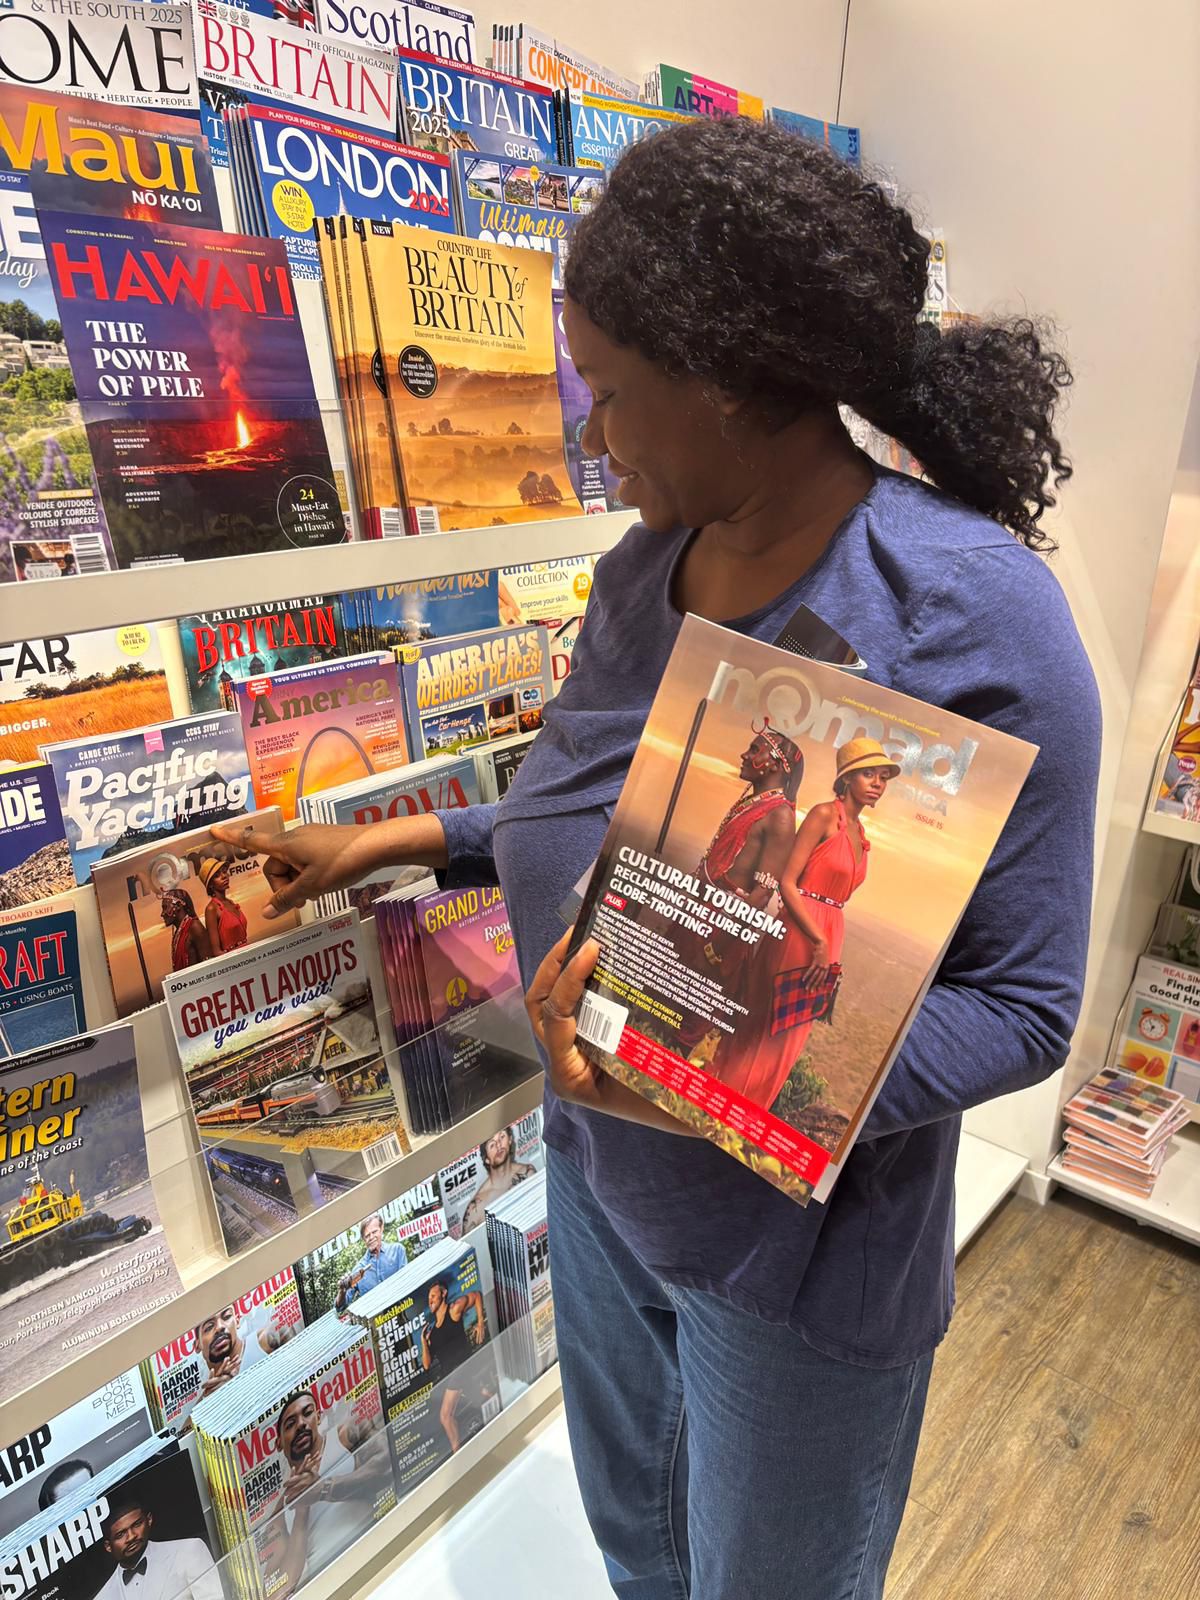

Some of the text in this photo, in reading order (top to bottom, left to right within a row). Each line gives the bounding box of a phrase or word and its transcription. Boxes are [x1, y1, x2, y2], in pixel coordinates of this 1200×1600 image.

[31, 1, 183, 24] & THE SOUTH 2025
[424, 4, 468, 21] CLANS HISTORY
[327, 0, 473, 66] Scotland
[0, 14, 190, 94] OME
[306, 39, 321, 51] THE
[323, 42, 355, 61] OFFICIAL
[356, 54, 395, 72] MAGAZINE
[202, 16, 394, 122] BRITAIN
[449, 60, 525, 87] ESSENTIAL GUIDE
[539, 41, 633, 98] BEST DIGITAL GAMES
[203, 71, 294, 100] HISTORY TRAVEL CULTURE
[107, 94, 153, 105] HERITAGE
[160, 98, 193, 107] PEOPLE
[401, 62, 551, 143] BRITAIN
[269, 111, 358, 140] PLAN YOUR PERFECT PAGES
[411, 110, 450, 139] 2025
[0, 101, 201, 194] Maui
[504, 142, 540, 162] GREAT
[254, 120, 448, 208] LONDON
[131, 189, 157, 207] NŌ
[280, 185, 302, 197] WIN
[409, 189, 450, 217] 2025
[281, 204, 294, 212] STAY
[480, 203, 568, 239] Ultimate
[288, 220, 306, 229] HOTEL
[373, 226, 392, 236] NEW
[437, 240, 492, 260] COUNTRY LIFE
[403, 246, 528, 301] BEAUTY of
[409, 287, 525, 339] BRITAIN
[86, 321, 147, 344] THE
[92, 348, 191, 372] POWER
[408, 354, 424, 362] Inside
[98, 376, 205, 398] OF PELE
[57, 499, 96, 508] OUTDOORS,
[291, 502, 329, 513] Must-Eat
[299, 488, 314, 501] 24
[18, 509, 63, 520] COLOURS OF
[30, 515, 99, 528] STYLISH STAIRCASES
[294, 524, 303, 532] in
[298, 512, 326, 522] Dishes
[517, 571, 569, 588] COLLECTION
[576, 576, 588, 589] 19
[201, 596, 323, 622] ARANORMAL
[520, 595, 569, 609] Improve your skills
[193, 606, 337, 673] BRITAIN
[0, 636, 75, 681] FAR
[418, 631, 539, 682] AMERICA'S
[274, 658, 377, 684] YOUR ULTIMATE TRAVEL COMPANION
[417, 650, 543, 710] WEIRDEST PLACES!
[250, 678, 391, 728] America
[0, 718, 50, 736] BIGGER.
[79, 748, 101, 761] CANOE
[102, 745, 121, 757] COVE
[10, 778, 23, 787] U.S.
[65, 747, 219, 812] Pacific
[260, 767, 295, 780] ROCKET CITY
[62, 775, 251, 850] Yachting
[914, 812, 944, 831] ISSUE 15
[229, 860, 260, 876] FRICA
[604, 893, 624, 910] PLUS:
[613, 864, 761, 945] RECLAIMING THE LURE OF
[618, 846, 788, 941] CULTURAL TOURISM:
[35, 906, 54, 916] SKIFF
[424, 890, 479, 934] GRAND
[609, 879, 714, 939] GLOBE-TROTTING?
[656, 935, 675, 949] KENYA
[0, 931, 67, 990] RAFT
[171, 931, 323, 993] 90+ MUST-SEE DESTINATIONS HANDY LOCATION MAP
[1162, 967, 1186, 981] REAL
[20, 983, 74, 1005] USING BOATS
[180, 938, 358, 1040] GREAT LAYOUTS
[1149, 984, 1180, 1001] Good
[214, 968, 337, 1049] you can visit!
[710, 1016, 735, 1034] TOURISM
[18, 1137, 84, 1170] of the Coast
[440, 1151, 478, 1178] STRENGTH
[444, 1163, 477, 1193] SIZE
[399, 1214, 442, 1239] WILLIAM MACY
[100, 1245, 164, 1278] Waterfront
[18, 1264, 147, 1328] NORTHERN VANCOUVER ISLAND
[460, 1274, 479, 1292] FUN!
[16, 1266, 170, 1343] Port Hardy, Telegraph Cove Kelsey Bay
[61, 1295, 171, 1351] ALUMINUM BOATBUILDERS
[376, 1316, 399, 1338] THE
[378, 1312, 426, 1351] SCIENCE
[381, 1347, 395, 1362] OF
[383, 1345, 419, 1377] AGING
[161, 1361, 199, 1392] AARON
[238, 1334, 369, 1440] THE BREAKTHROUGH ISSUE
[384, 1362, 416, 1389] WELL
[105, 1389, 134, 1411] FOR
[163, 1374, 202, 1406] PIERRE
[106, 1397, 136, 1420] MEN
[244, 1460, 281, 1496] AARON
[246, 1473, 284, 1507] PIERRE
[2, 1495, 110, 1600] SHARP
